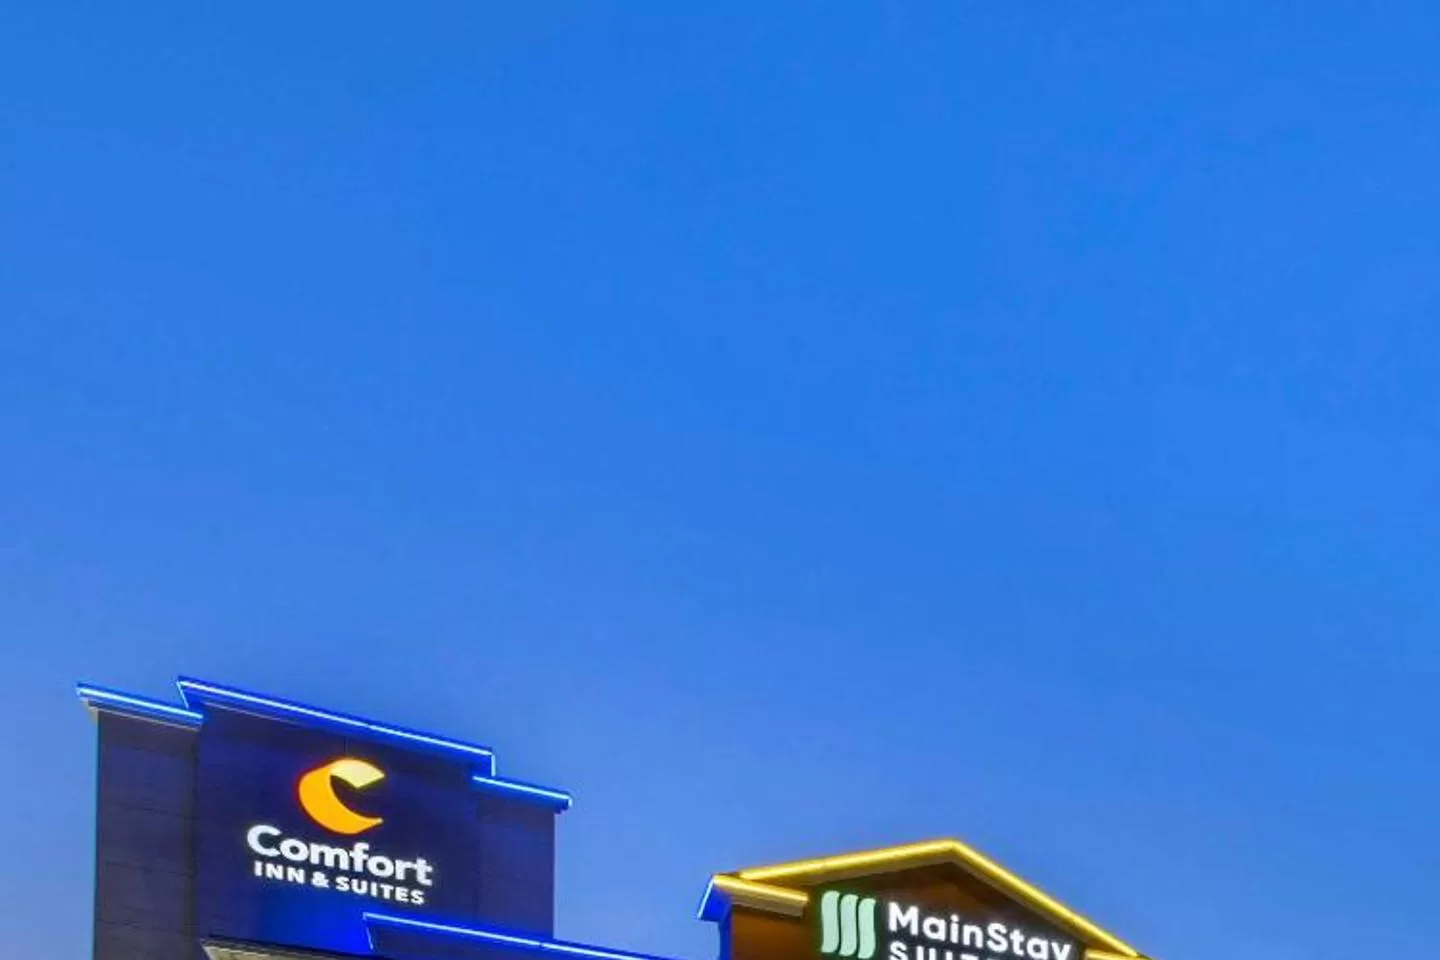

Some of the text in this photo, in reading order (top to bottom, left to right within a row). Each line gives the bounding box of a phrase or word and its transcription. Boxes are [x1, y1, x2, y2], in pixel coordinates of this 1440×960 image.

[246, 824, 433, 886] Comfort
[253, 860, 426, 905] INN & SUITES
